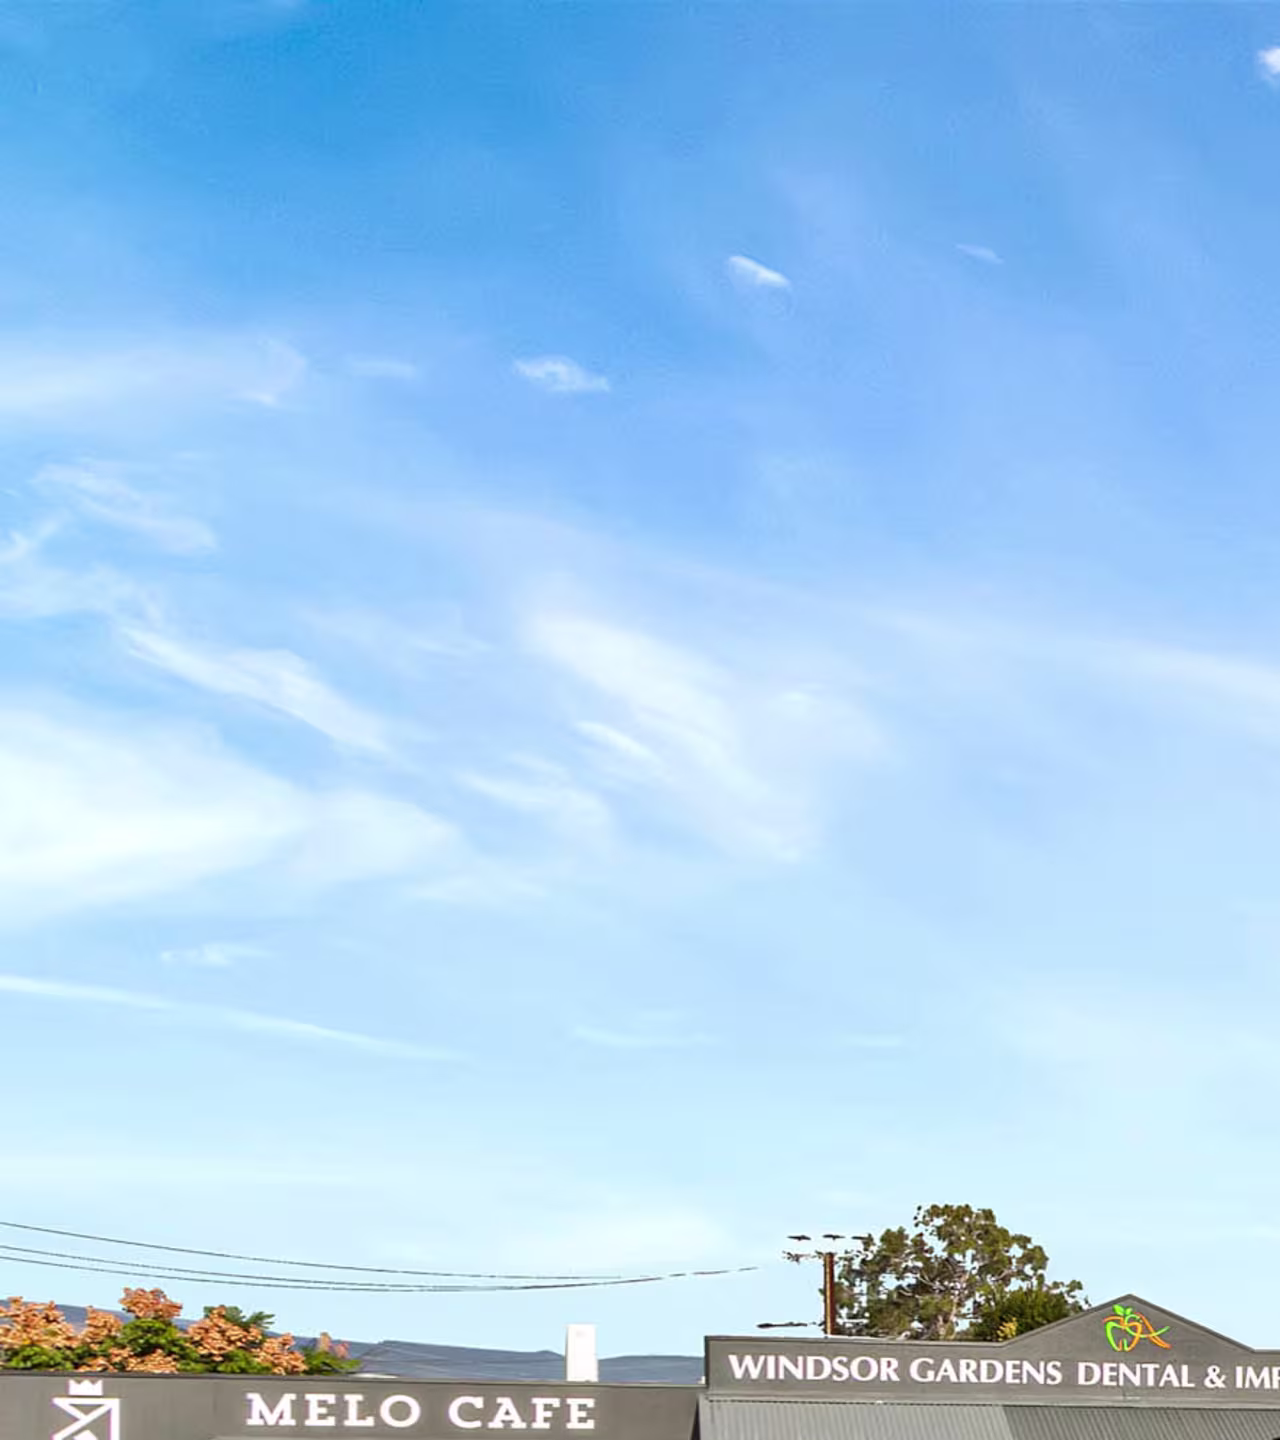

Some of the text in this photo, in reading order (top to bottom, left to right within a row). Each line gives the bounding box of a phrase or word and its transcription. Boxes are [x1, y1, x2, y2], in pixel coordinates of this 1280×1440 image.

[728, 1354, 899, 1382] WINDSOR
[910, 1357, 1062, 1385] GARDENS
[1078, 1362, 1195, 1388] DENTAL
[1204, 1366, 1226, 1389] &
[246, 1393, 596, 1429] MELO CAFE
